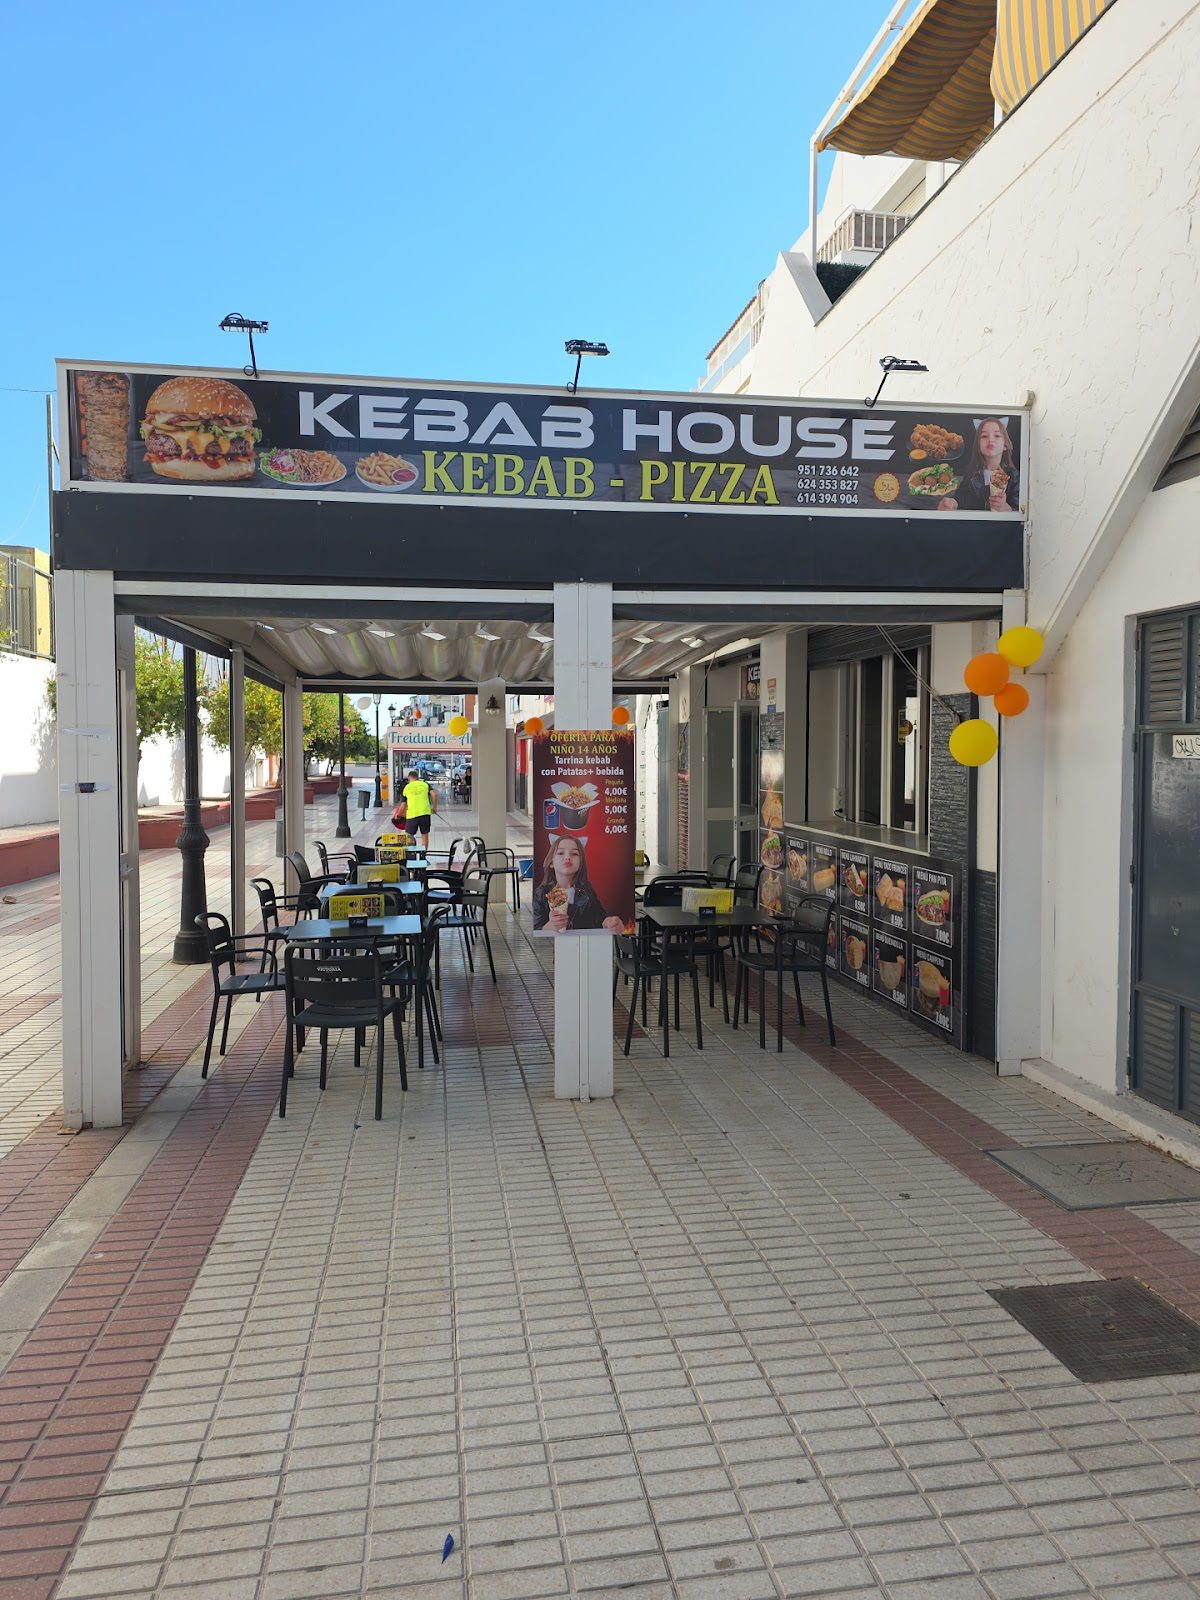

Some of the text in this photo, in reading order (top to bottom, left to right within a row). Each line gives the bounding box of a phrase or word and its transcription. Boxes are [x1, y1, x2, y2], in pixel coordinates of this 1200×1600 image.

[299, 390, 897, 461] KEBAB HOUSE
[797, 464, 859, 477] 951 736 642
[422, 450, 780, 506] KEBAB - PIZZA
[797, 478, 859, 491] 624 353 827
[797, 492, 859, 504] 614 394 904
[550, 733, 616, 742] OFERTA PARA
[550, 744, 618, 754] NIÑO 14 AÑOS
[554, 756, 611, 764] Tarrina kebab
[596, 767, 624, 776] bebida
[604, 787, 628, 796] 4,00€
[604, 805, 628, 814] 5,00€
[604, 825, 628, 834] 6,00€
